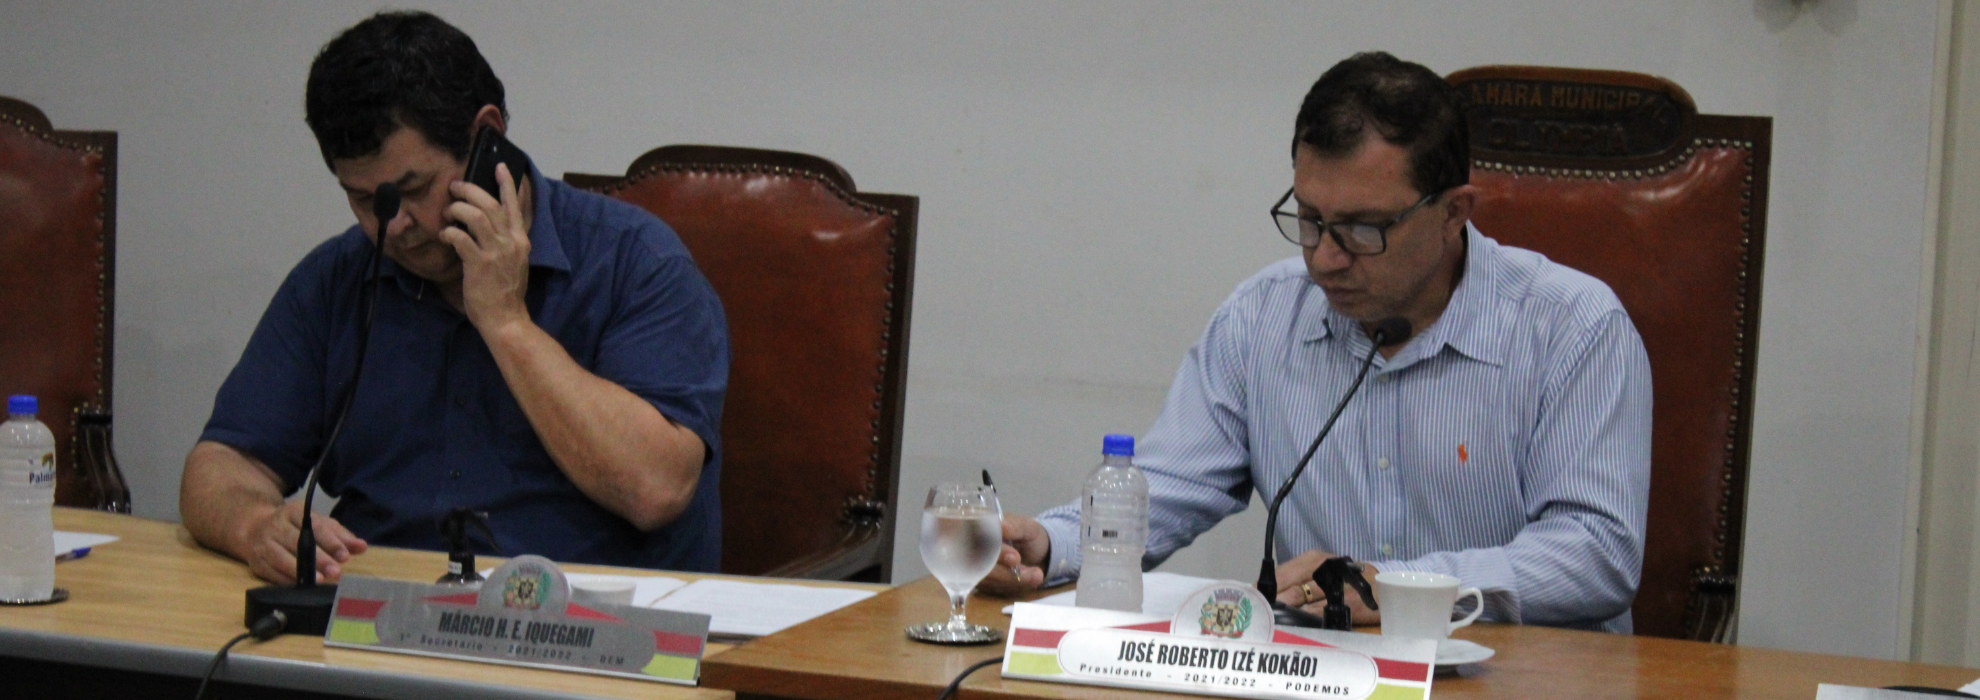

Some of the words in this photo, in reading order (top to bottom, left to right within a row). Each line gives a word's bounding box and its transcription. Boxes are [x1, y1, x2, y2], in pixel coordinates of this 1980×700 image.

[437, 610, 495, 637] MÁRCIO
[495, 617, 508, 639] H.
[511, 619, 521, 640] E.
[525, 621, 595, 648] IQUEGAMI
[508, 645, 571, 661] 2021/2022
[599, 655, 624, 665] DEM
[1117, 639, 1156, 663] JOSÉ
[1157, 644, 1229, 670] ROBERTO
[1257, 651, 1318, 678] KOKÃO)
[1079, 663, 1152, 678] Presidente
[1184, 672, 1257, 687] 2021/2022
[1285, 681, 1350, 696] PODEMOS
